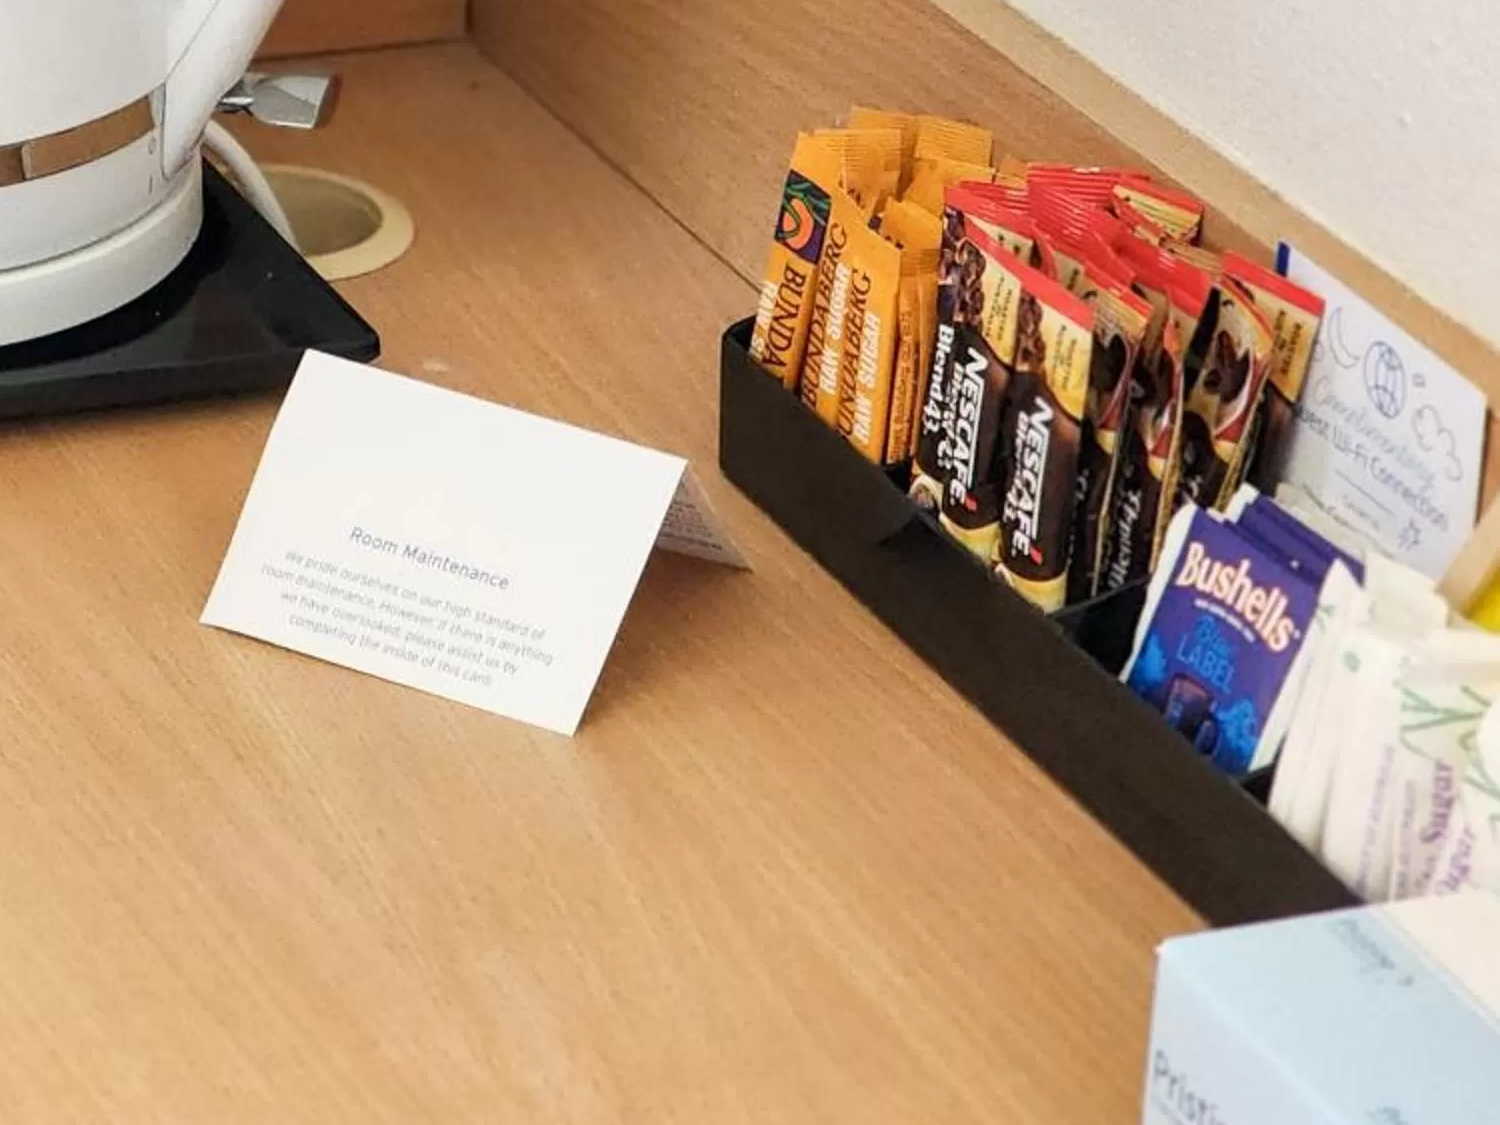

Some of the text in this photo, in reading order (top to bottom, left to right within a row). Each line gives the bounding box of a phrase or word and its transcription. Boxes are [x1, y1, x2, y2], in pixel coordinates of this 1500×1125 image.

[761, 262, 807, 368] BUNDA
[819, 262, 850, 395] RAW SUGAR
[837, 266, 872, 436] UNDABERG
[852, 309, 881, 445] RAW SUGAR
[348, 526, 510, 590] Room Maintenance
[1175, 541, 1295, 652] Bushells
[1420, 759, 1455, 844] Sugar
[1154, 1048, 1227, 1125] Pristi
